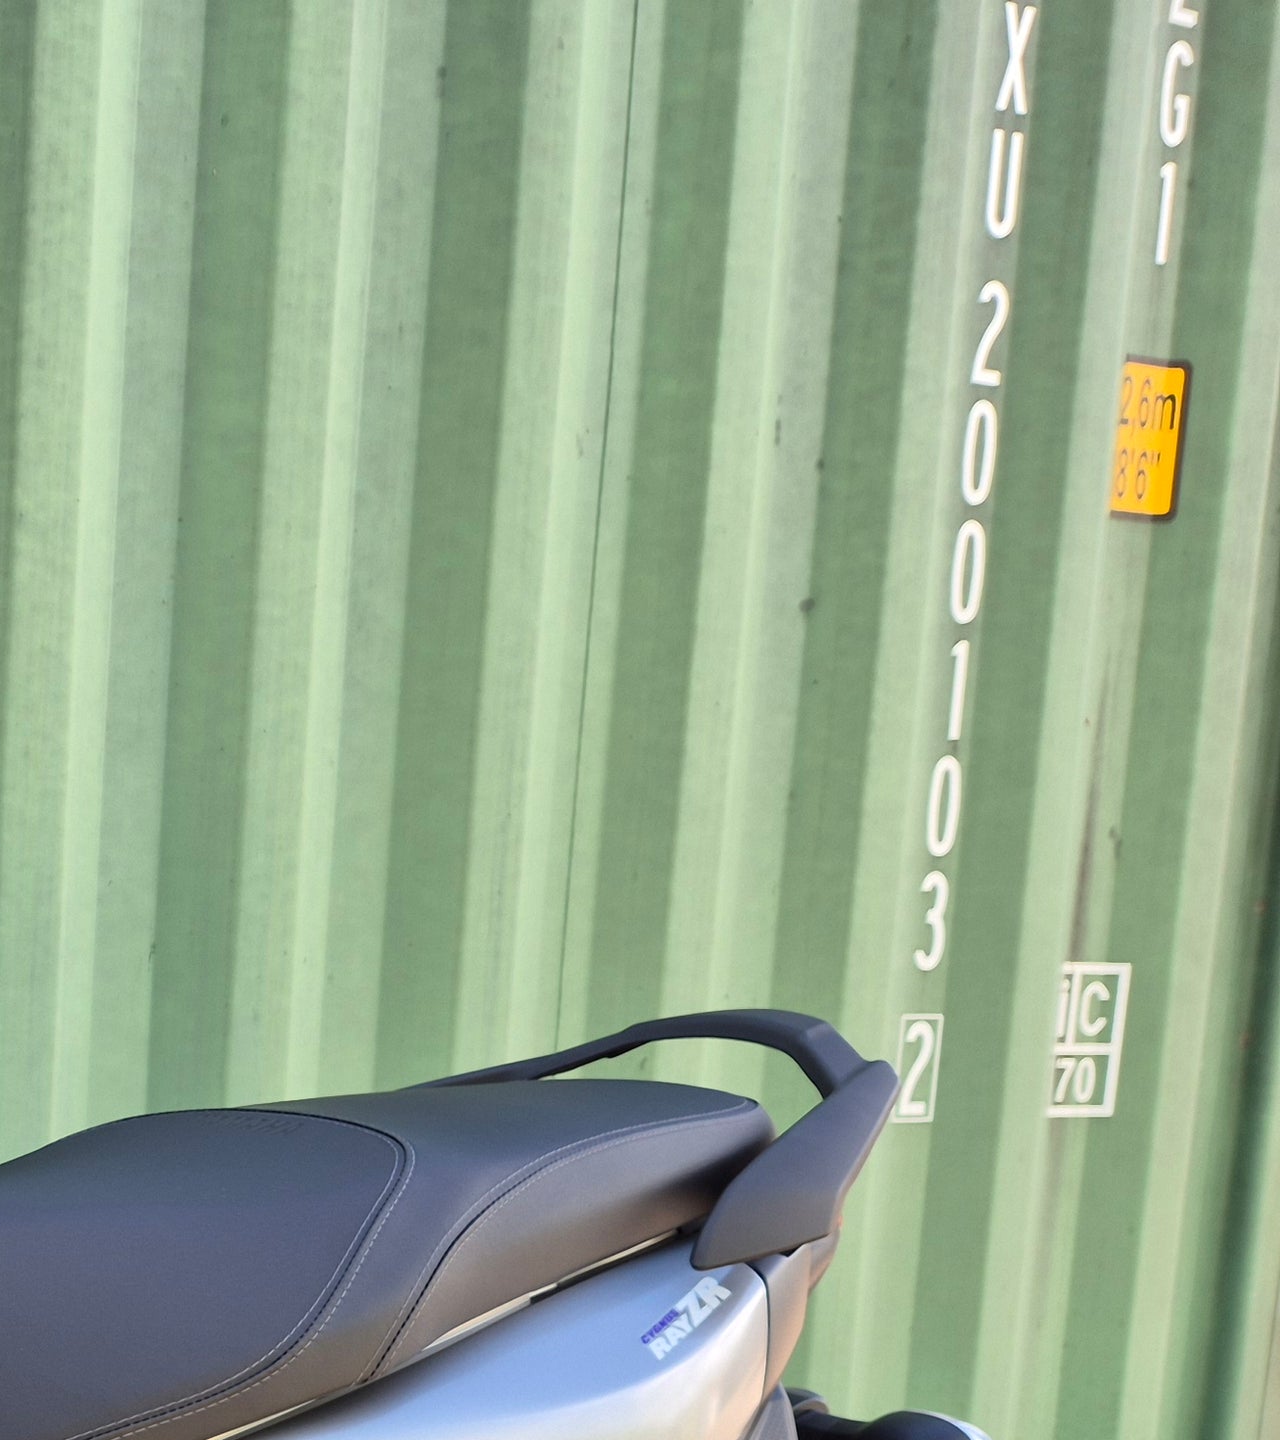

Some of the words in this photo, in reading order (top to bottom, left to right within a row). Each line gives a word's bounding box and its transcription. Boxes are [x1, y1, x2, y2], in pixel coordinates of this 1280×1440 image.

[986, 1, 1037, 239] XU
[1155, 0, 1201, 266] G1
[914, 279, 1011, 971] 200103
[899, 1019, 934, 1117] 2
[1054, 1056, 1096, 1103] 70
[648, 1276, 733, 1361] RAYZR
